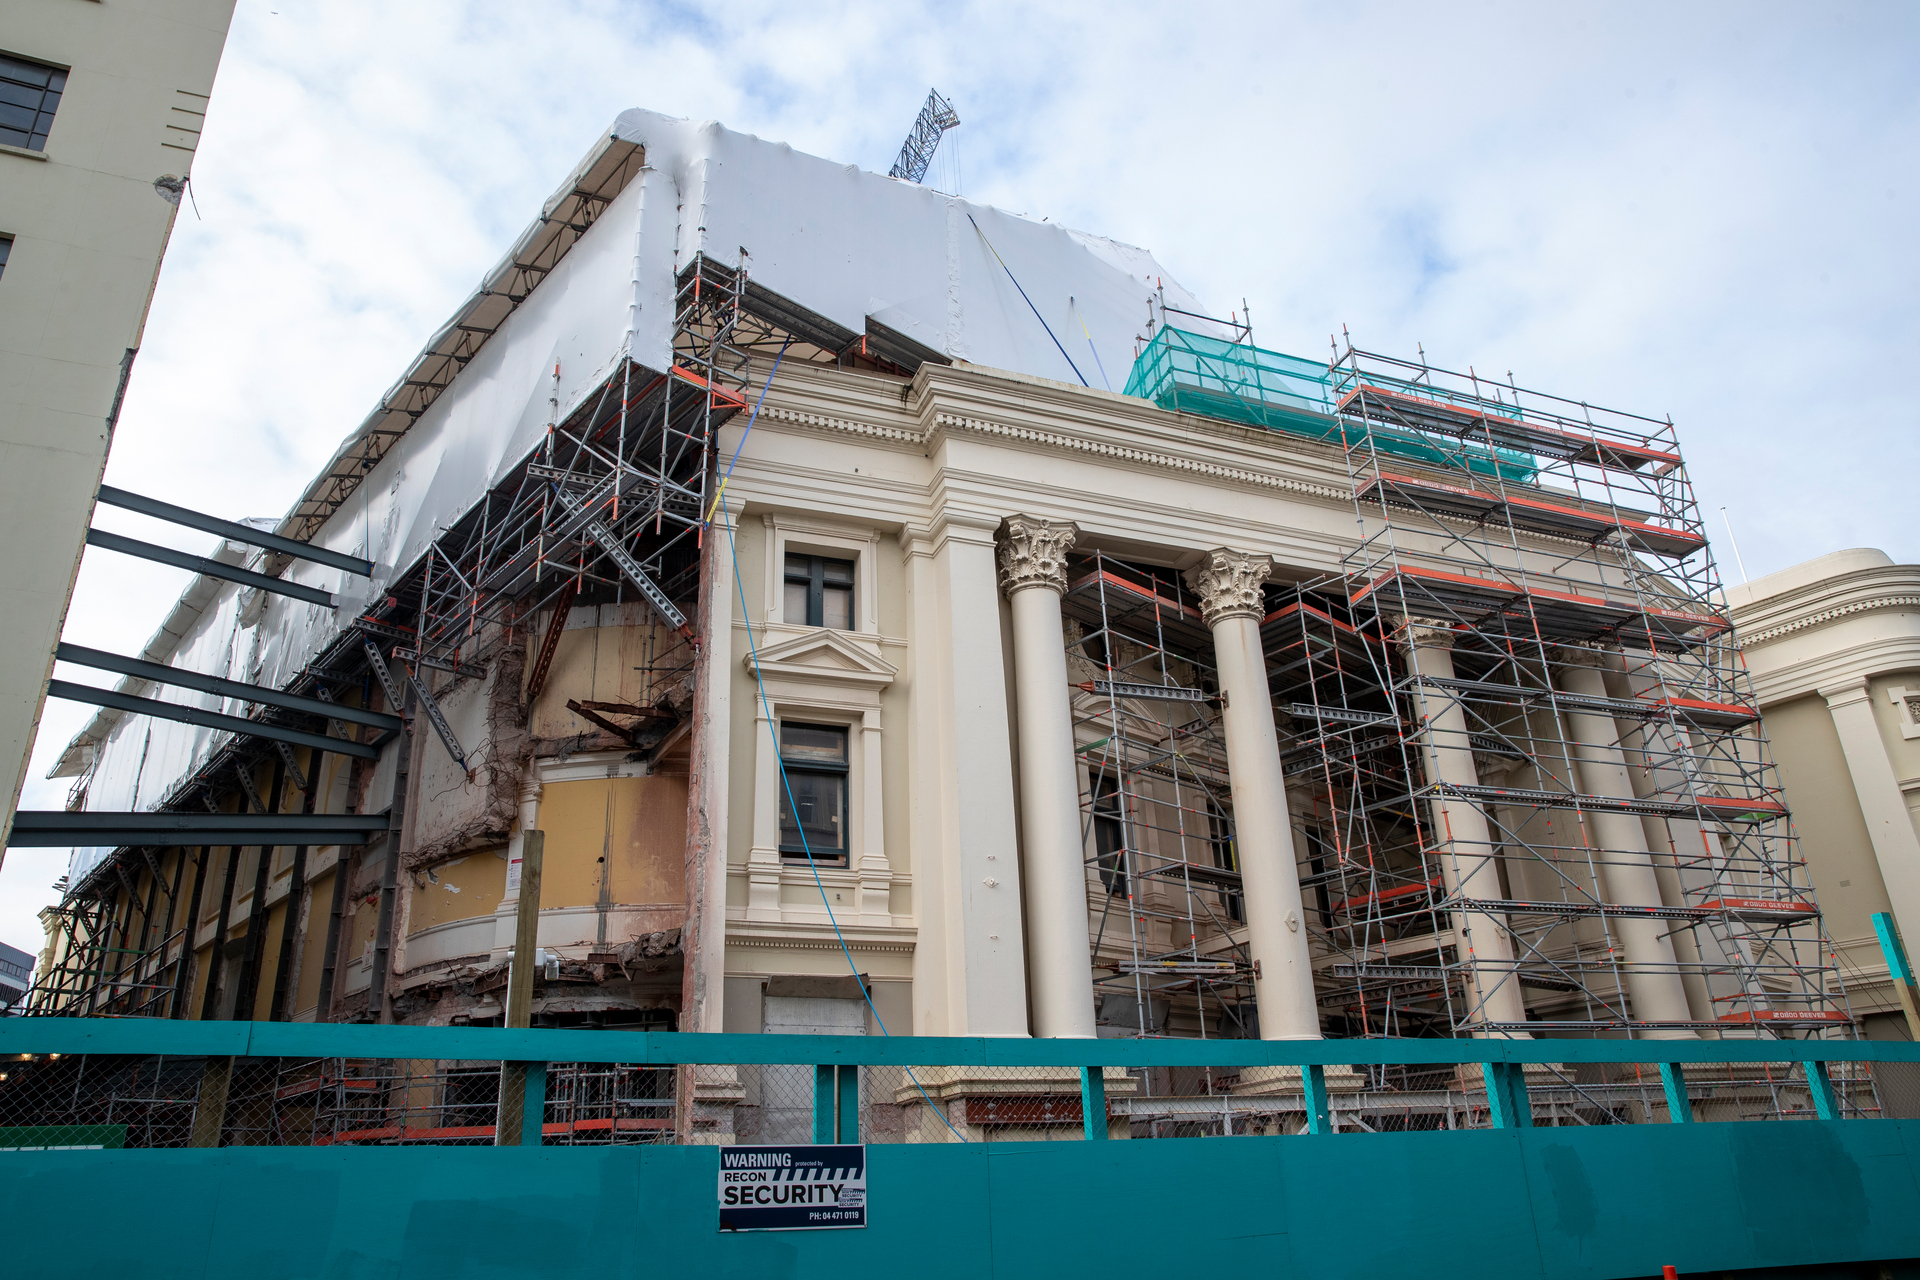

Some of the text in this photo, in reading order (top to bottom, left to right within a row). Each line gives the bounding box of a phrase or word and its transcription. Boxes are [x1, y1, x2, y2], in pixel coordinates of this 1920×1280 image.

[724, 1153, 792, 1168] WARNING
[724, 1172, 767, 1183] RECON
[723, 1184, 844, 1205] SECURITY
[809, 1211, 860, 1220] PH: 04 471 0119
